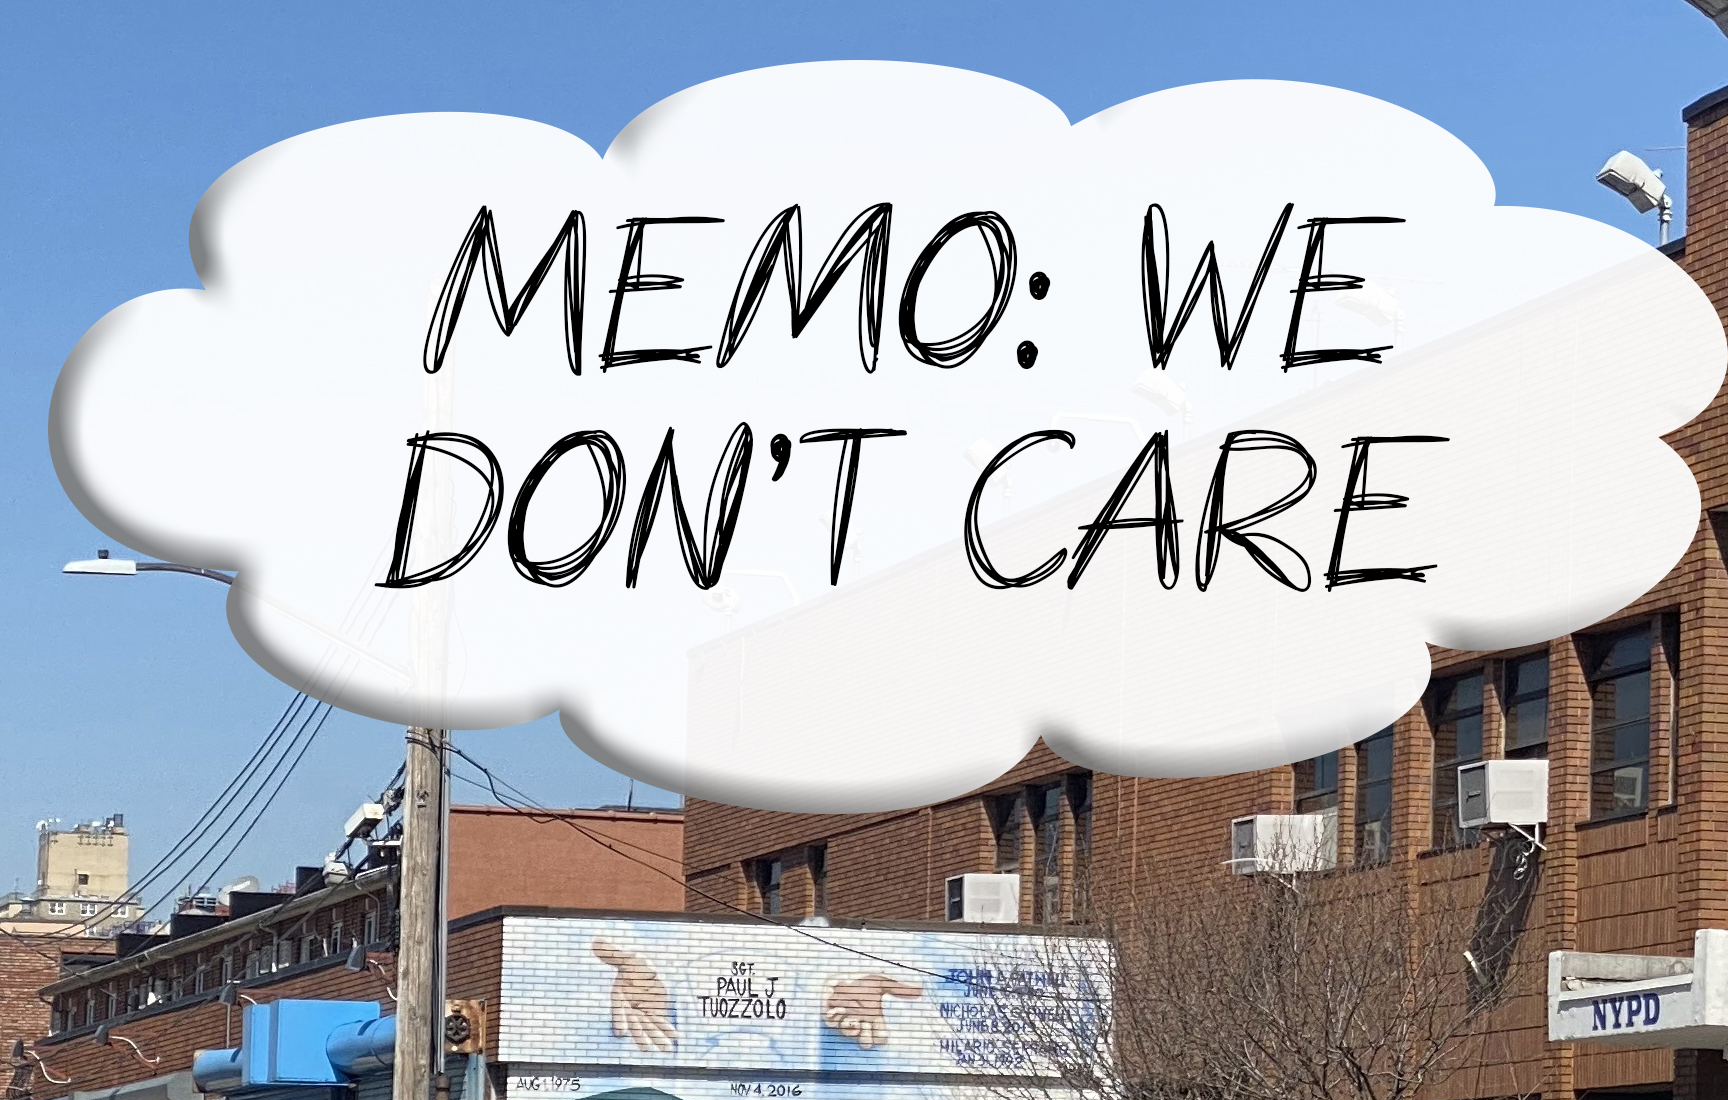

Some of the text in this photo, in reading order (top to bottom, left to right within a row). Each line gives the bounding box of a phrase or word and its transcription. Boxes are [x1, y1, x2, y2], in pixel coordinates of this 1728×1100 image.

[731, 961, 755, 976] SGT.
[717, 976, 778, 998] PAUL J
[699, 996, 786, 1019] TUOZZOLO
[1592, 993, 1661, 1031] NYPD
[516, 1077, 539, 1091] AUG
[731, 1083, 752, 1096] NOV
[768, 1084, 802, 1097] 2016
